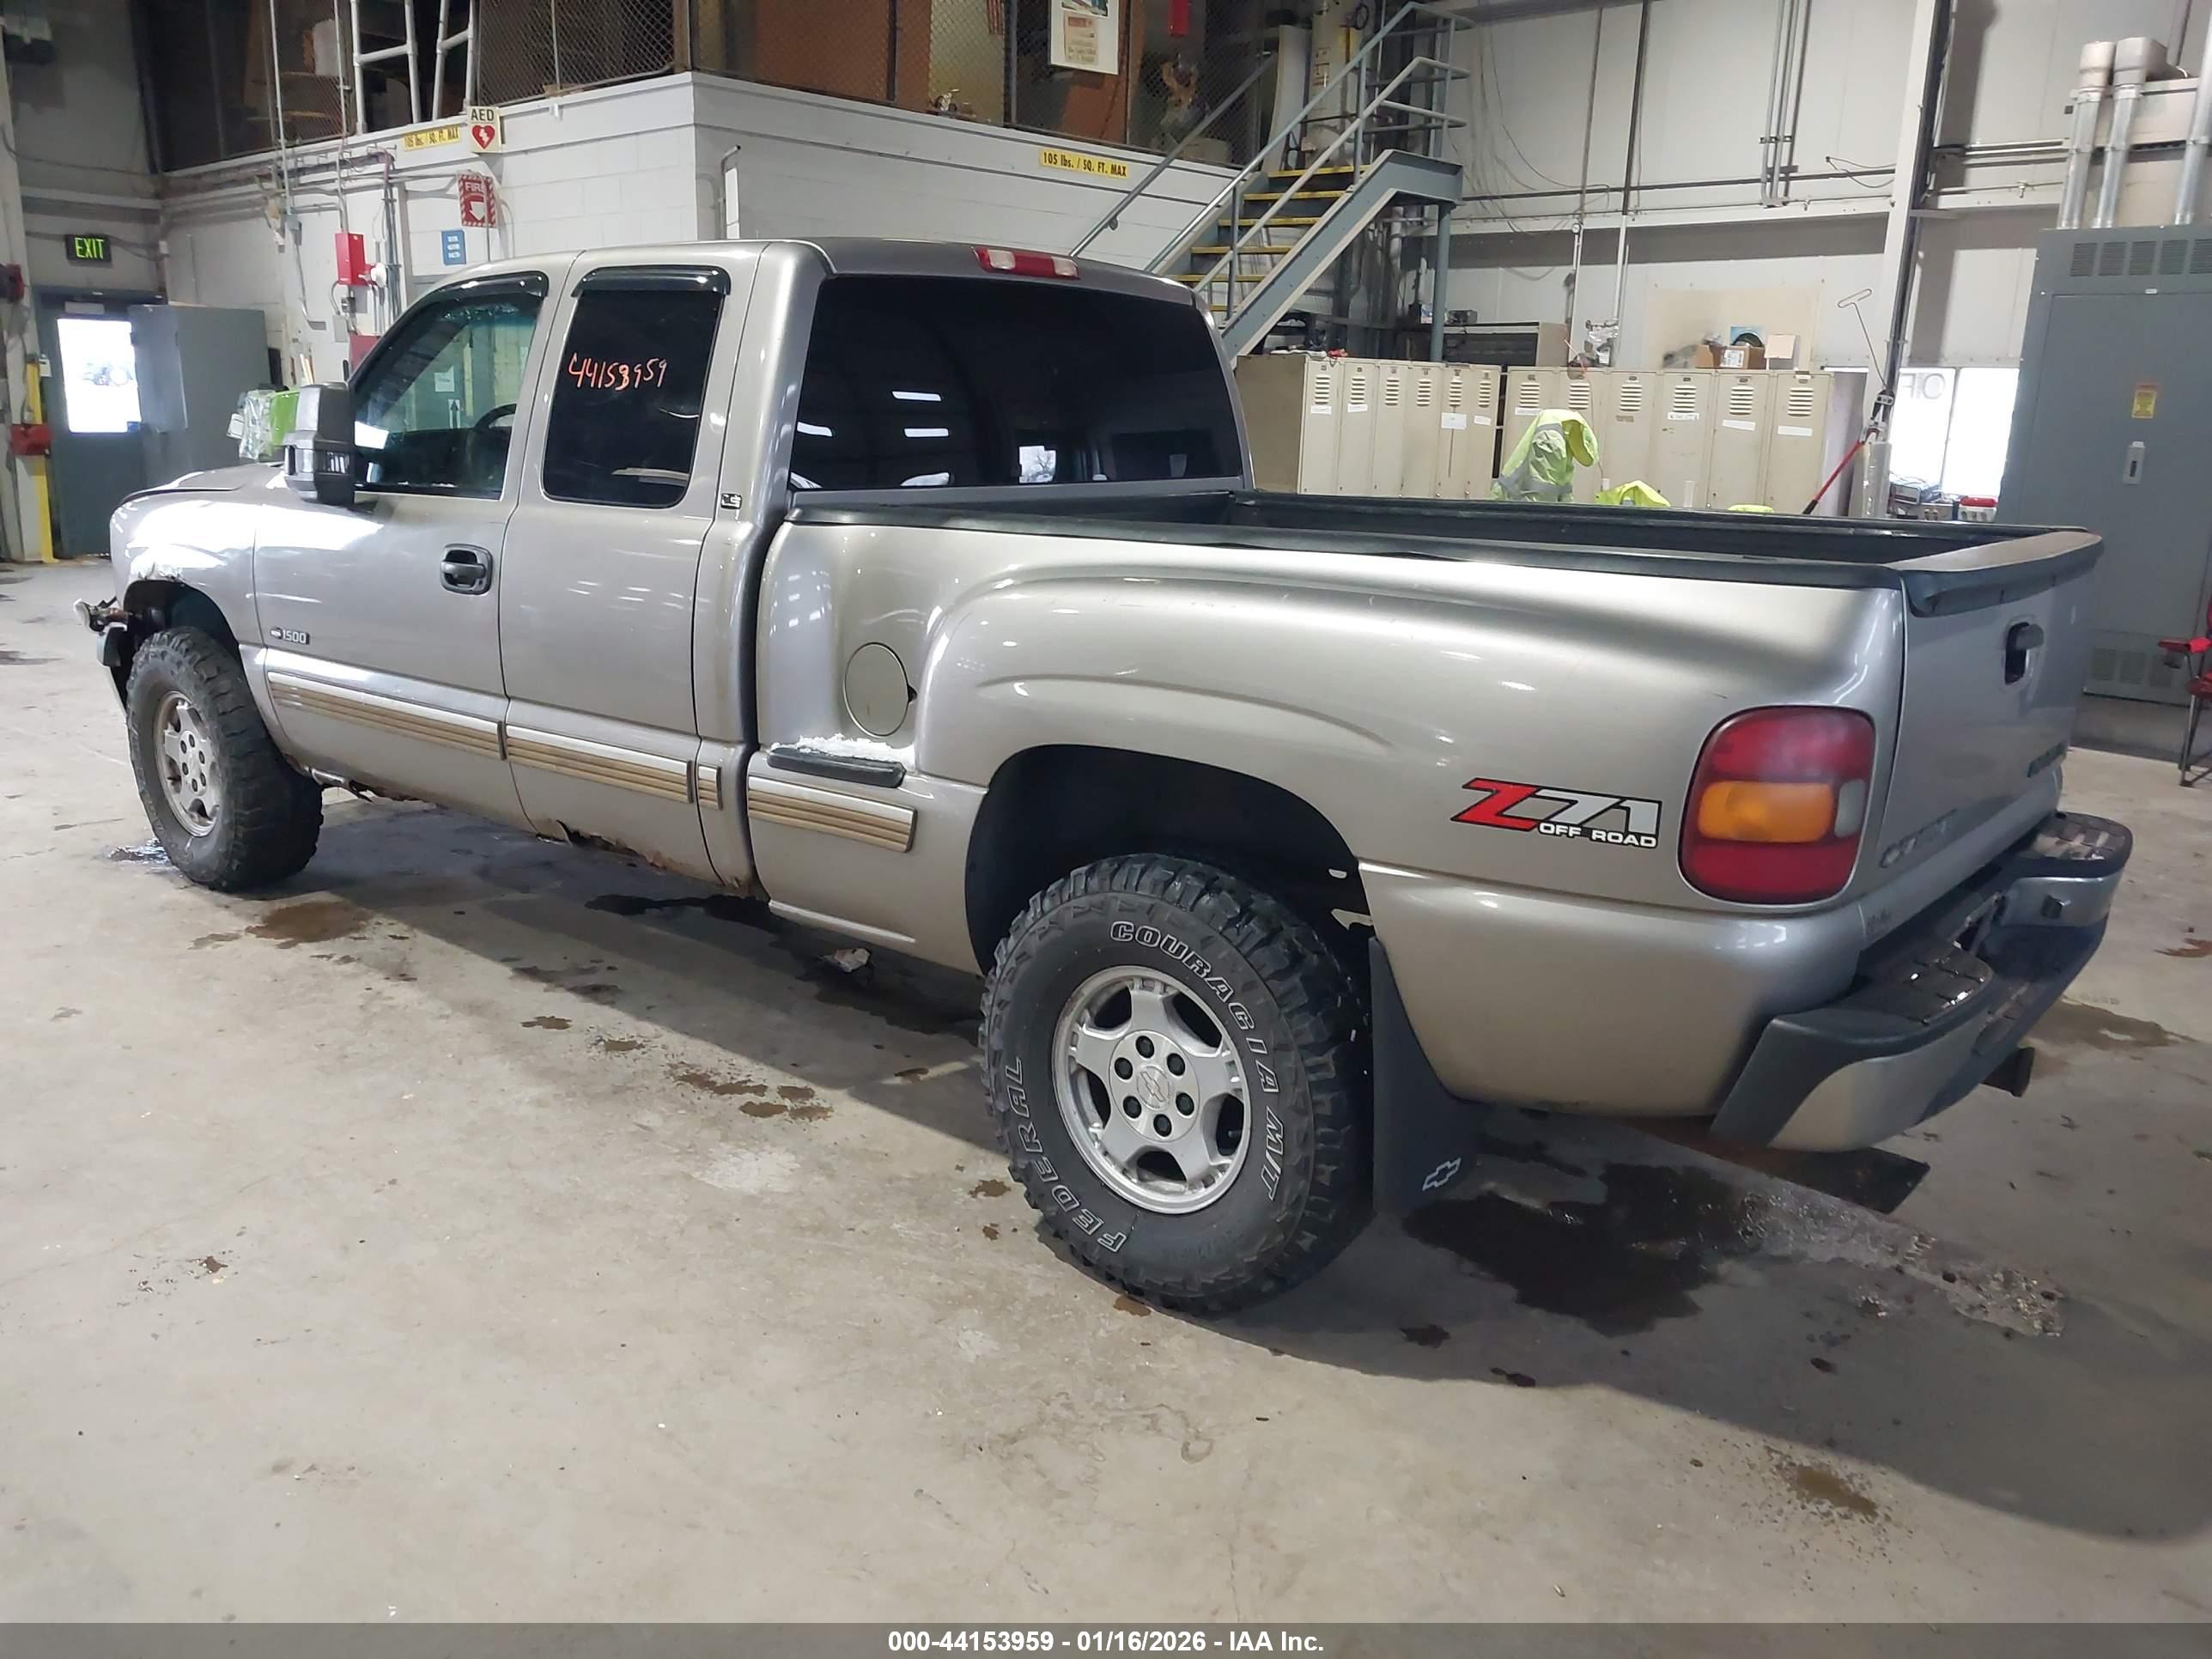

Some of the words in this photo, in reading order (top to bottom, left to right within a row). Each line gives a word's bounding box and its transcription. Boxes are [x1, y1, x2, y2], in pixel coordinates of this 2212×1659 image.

[471, 108, 495, 122] AED
[1043, 152, 1058, 165] 105
[1060, 155, 1074, 168] lbs.
[1083, 159, 1095, 173] SQ.
[1097, 161, 1109, 173] FT.
[1110, 163, 1127, 177] MAX
[75, 237, 104, 259] EXIT
[568, 352, 667, 391] 44153959
[282, 629, 307, 644] 1500
[1450, 777, 1662, 835] Z71
[1538, 822, 1583, 839] OFF
[1591, 830, 1658, 848] ROAD
[1109, 921, 1279, 1093] COURAGIA
[1261, 1105, 1285, 1201] M/T
[1006, 1056, 1127, 1253] FEDERAL
